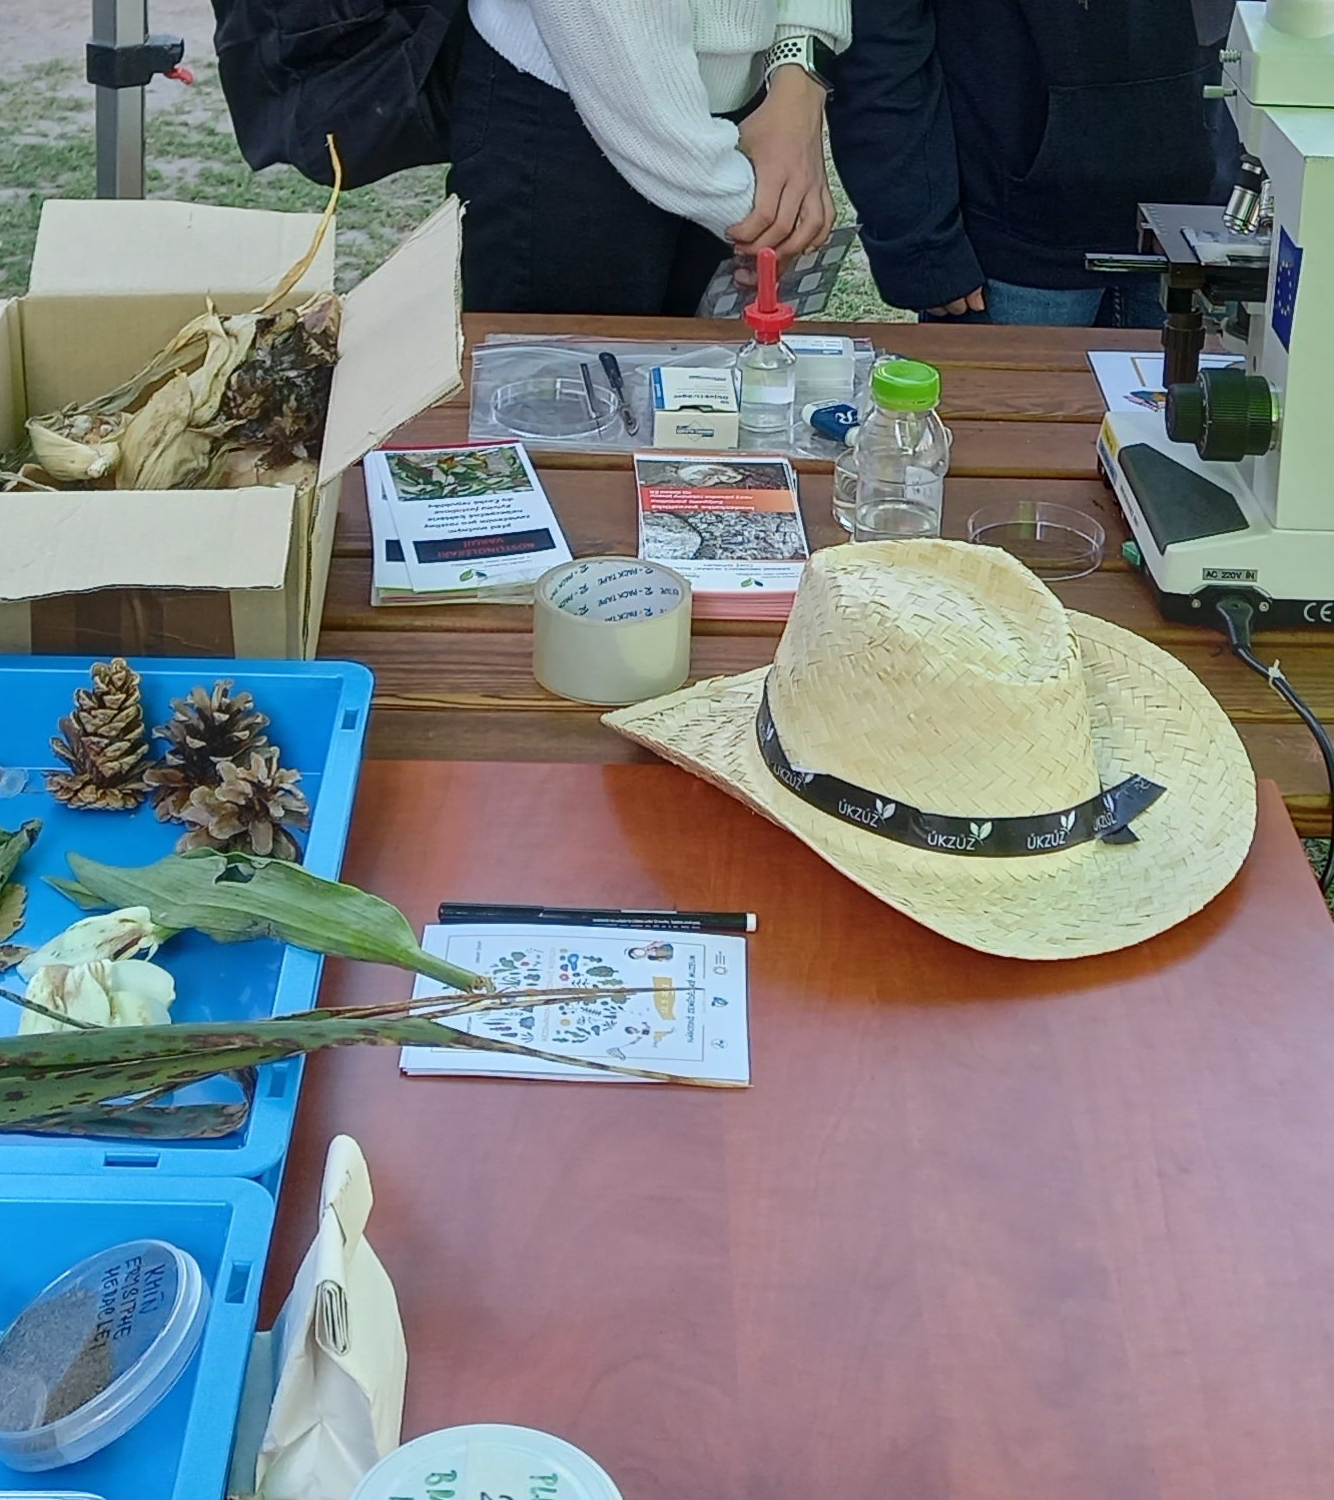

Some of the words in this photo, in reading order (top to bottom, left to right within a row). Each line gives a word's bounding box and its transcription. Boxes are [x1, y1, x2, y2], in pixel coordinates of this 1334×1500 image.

[1206, 571, 1218, 579] AC
[1246, 571, 1255, 579] IN
[1303, 602, 1334, 622] CE
[837, 799, 880, 829] ÚKZÚZ
[927, 830, 976, 851] ÚKZÚZ
[1026, 830, 1067, 851] ÚKZÚZ
